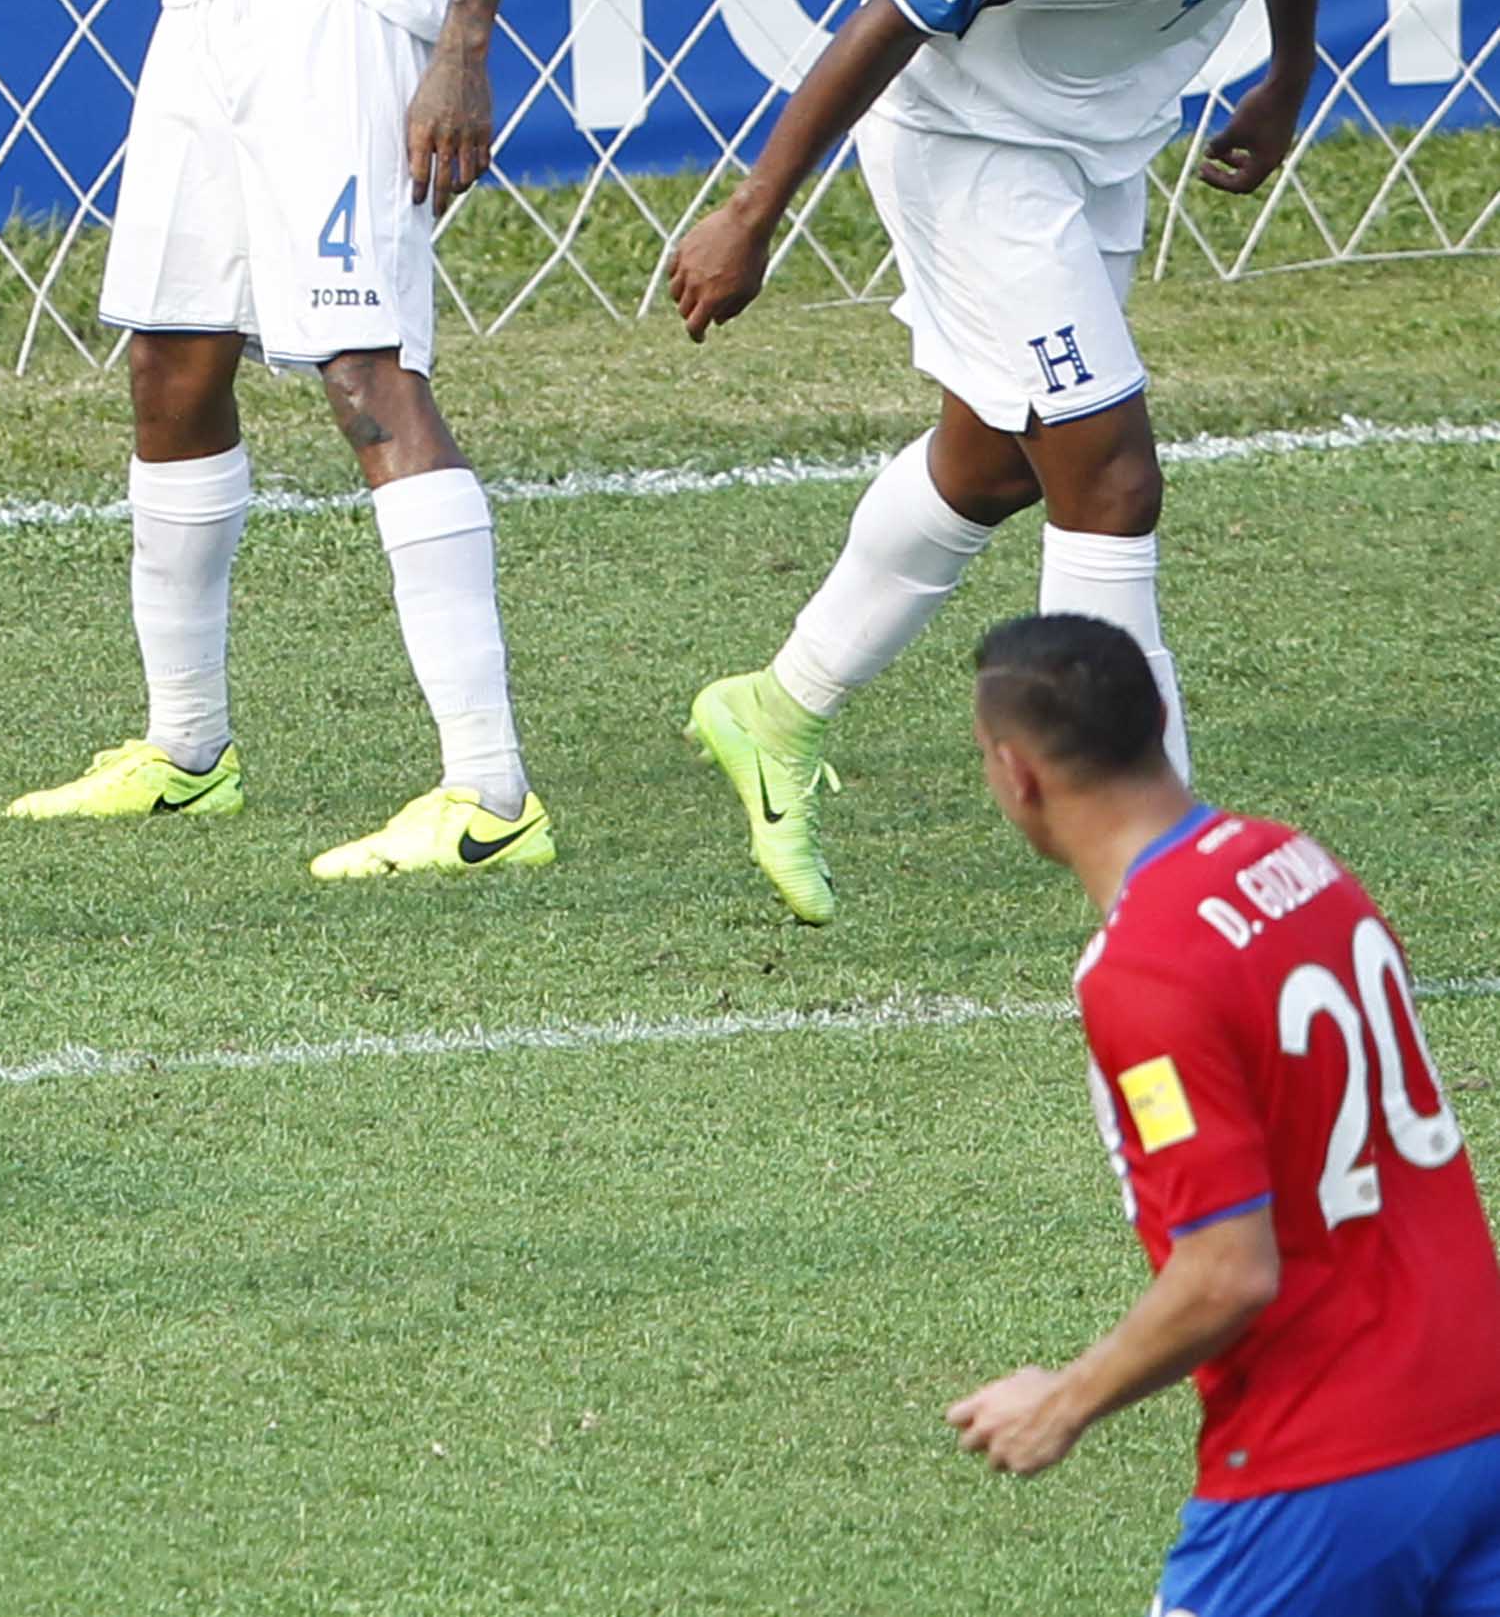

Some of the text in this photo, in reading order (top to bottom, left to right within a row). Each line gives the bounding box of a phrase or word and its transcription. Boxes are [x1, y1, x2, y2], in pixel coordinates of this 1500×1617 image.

[318, 174, 360, 272] 4
[1027, 324, 1094, 394] H
[1278, 916, 1465, 1233] 20
